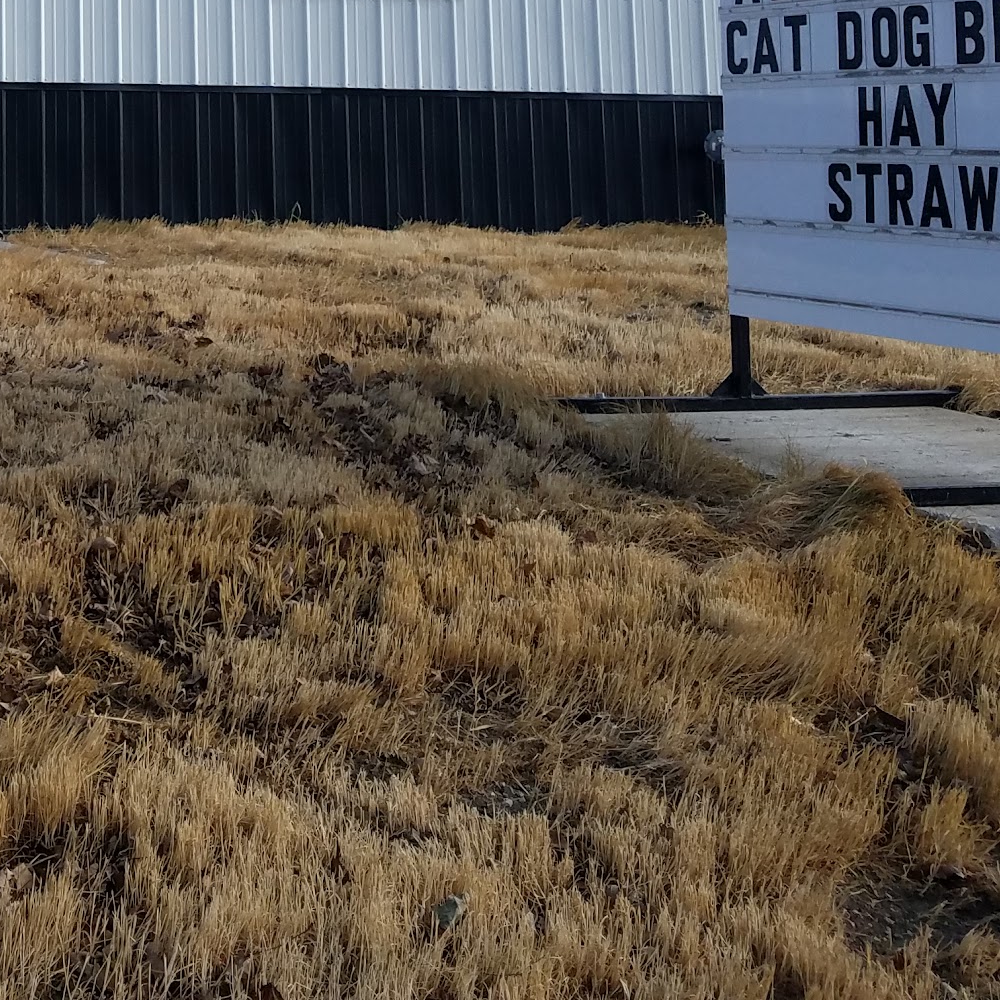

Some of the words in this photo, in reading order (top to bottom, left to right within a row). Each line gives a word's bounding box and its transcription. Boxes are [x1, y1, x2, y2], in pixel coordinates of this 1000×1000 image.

[727, 14, 807, 74] CAT
[837, 5, 930, 70] DOG
[857, 83, 952, 147] HAY
[828, 162, 998, 231] STRAW
